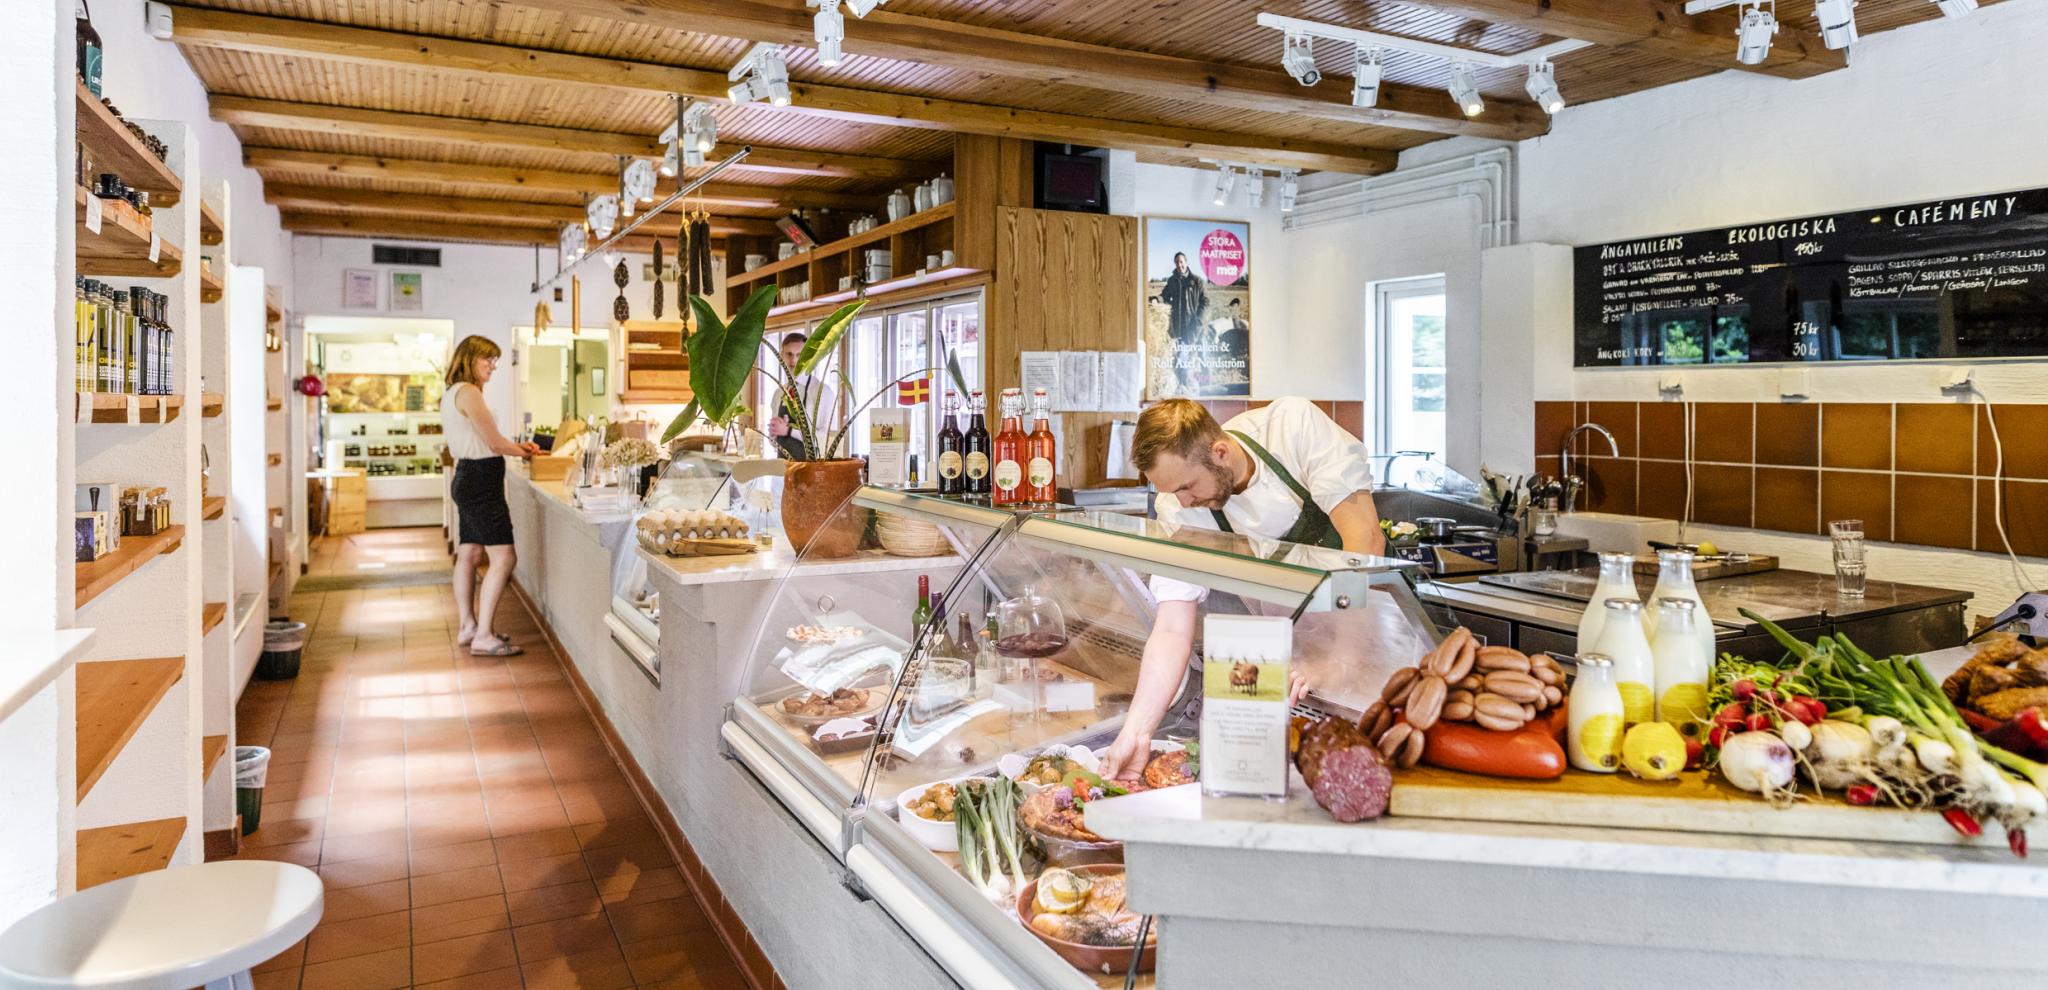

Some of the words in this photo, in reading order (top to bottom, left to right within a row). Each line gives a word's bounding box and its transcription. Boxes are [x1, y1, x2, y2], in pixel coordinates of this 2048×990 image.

[1208, 236, 1236, 247] STORA
[1600, 236, 1684, 259] ÄNGAVALLENS
[1728, 218, 1836, 244] EKOLOGISKA
[1201, 249, 1243, 259] MATPRISET
[1848, 262, 1885, 274] GRILLAD
[1848, 275, 1884, 287] DAGENS
[1888, 272, 1913, 285] SOPPA
[1921, 269, 1961, 281] SPARRIS
[1793, 321, 1808, 335] 75
[1220, 342, 1230, 352] &
[1793, 342, 1807, 356] 30
[1152, 357, 1175, 369] Rolf
[1176, 357, 1196, 369] Axel
[1198, 357, 1246, 369] Nordström
